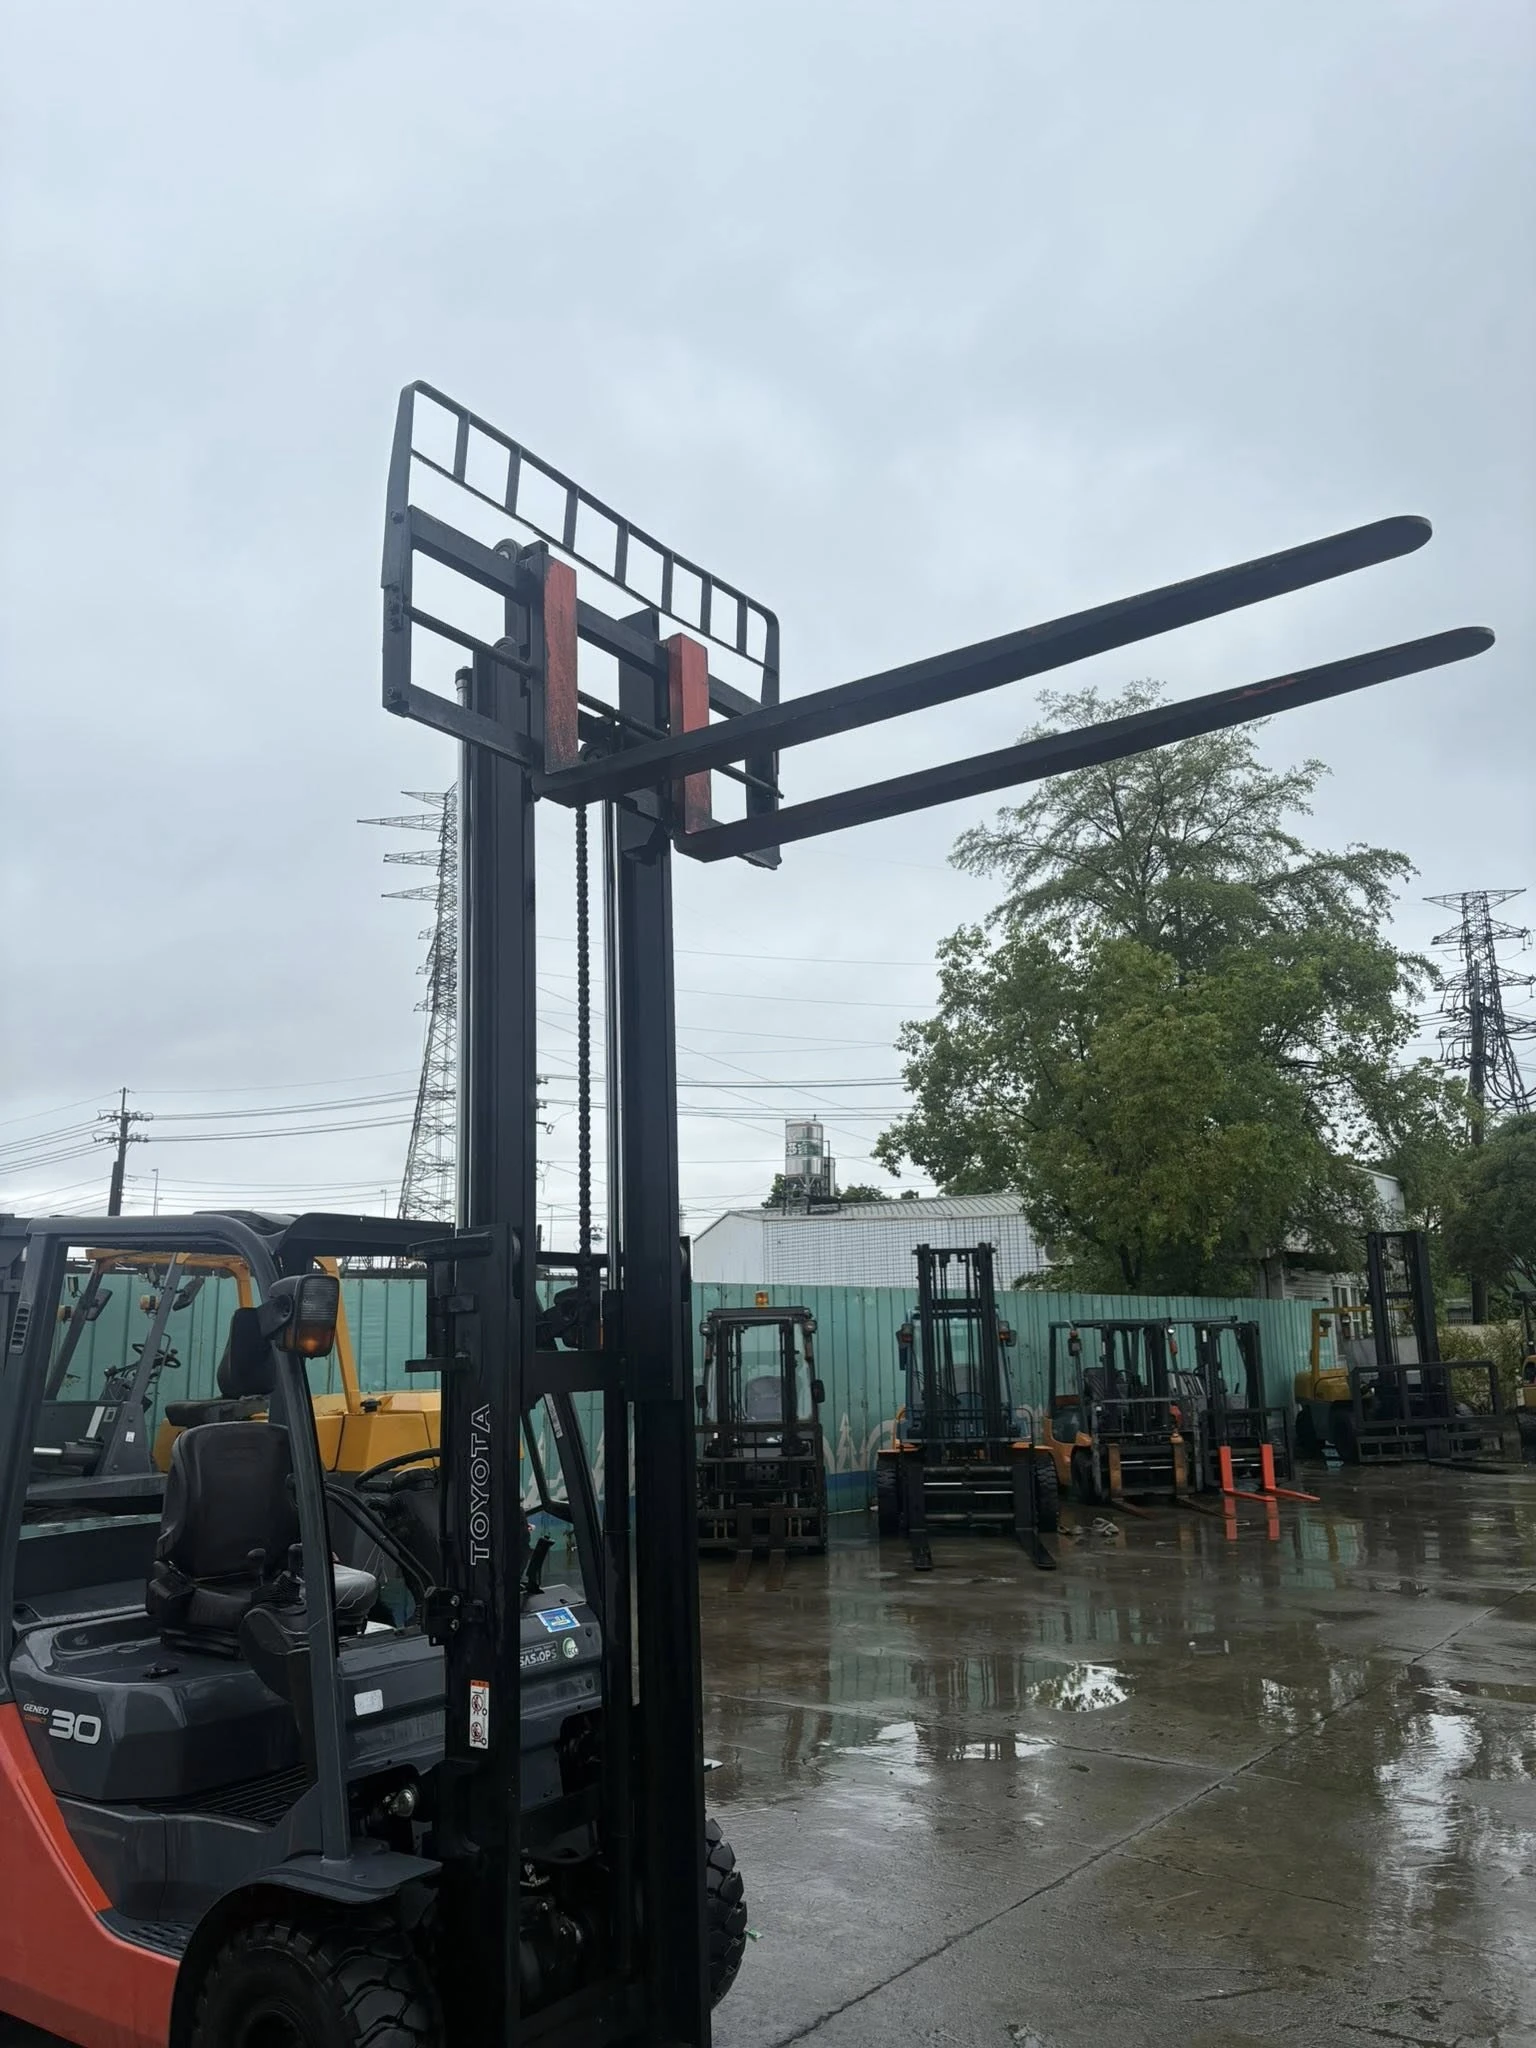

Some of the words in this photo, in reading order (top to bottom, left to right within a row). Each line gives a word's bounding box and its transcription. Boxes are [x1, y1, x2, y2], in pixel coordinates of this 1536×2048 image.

[470, 1404, 490, 1565] TOYOTA
[23, 1703, 49, 1715] GENEO
[48, 1709, 102, 1745] 30
